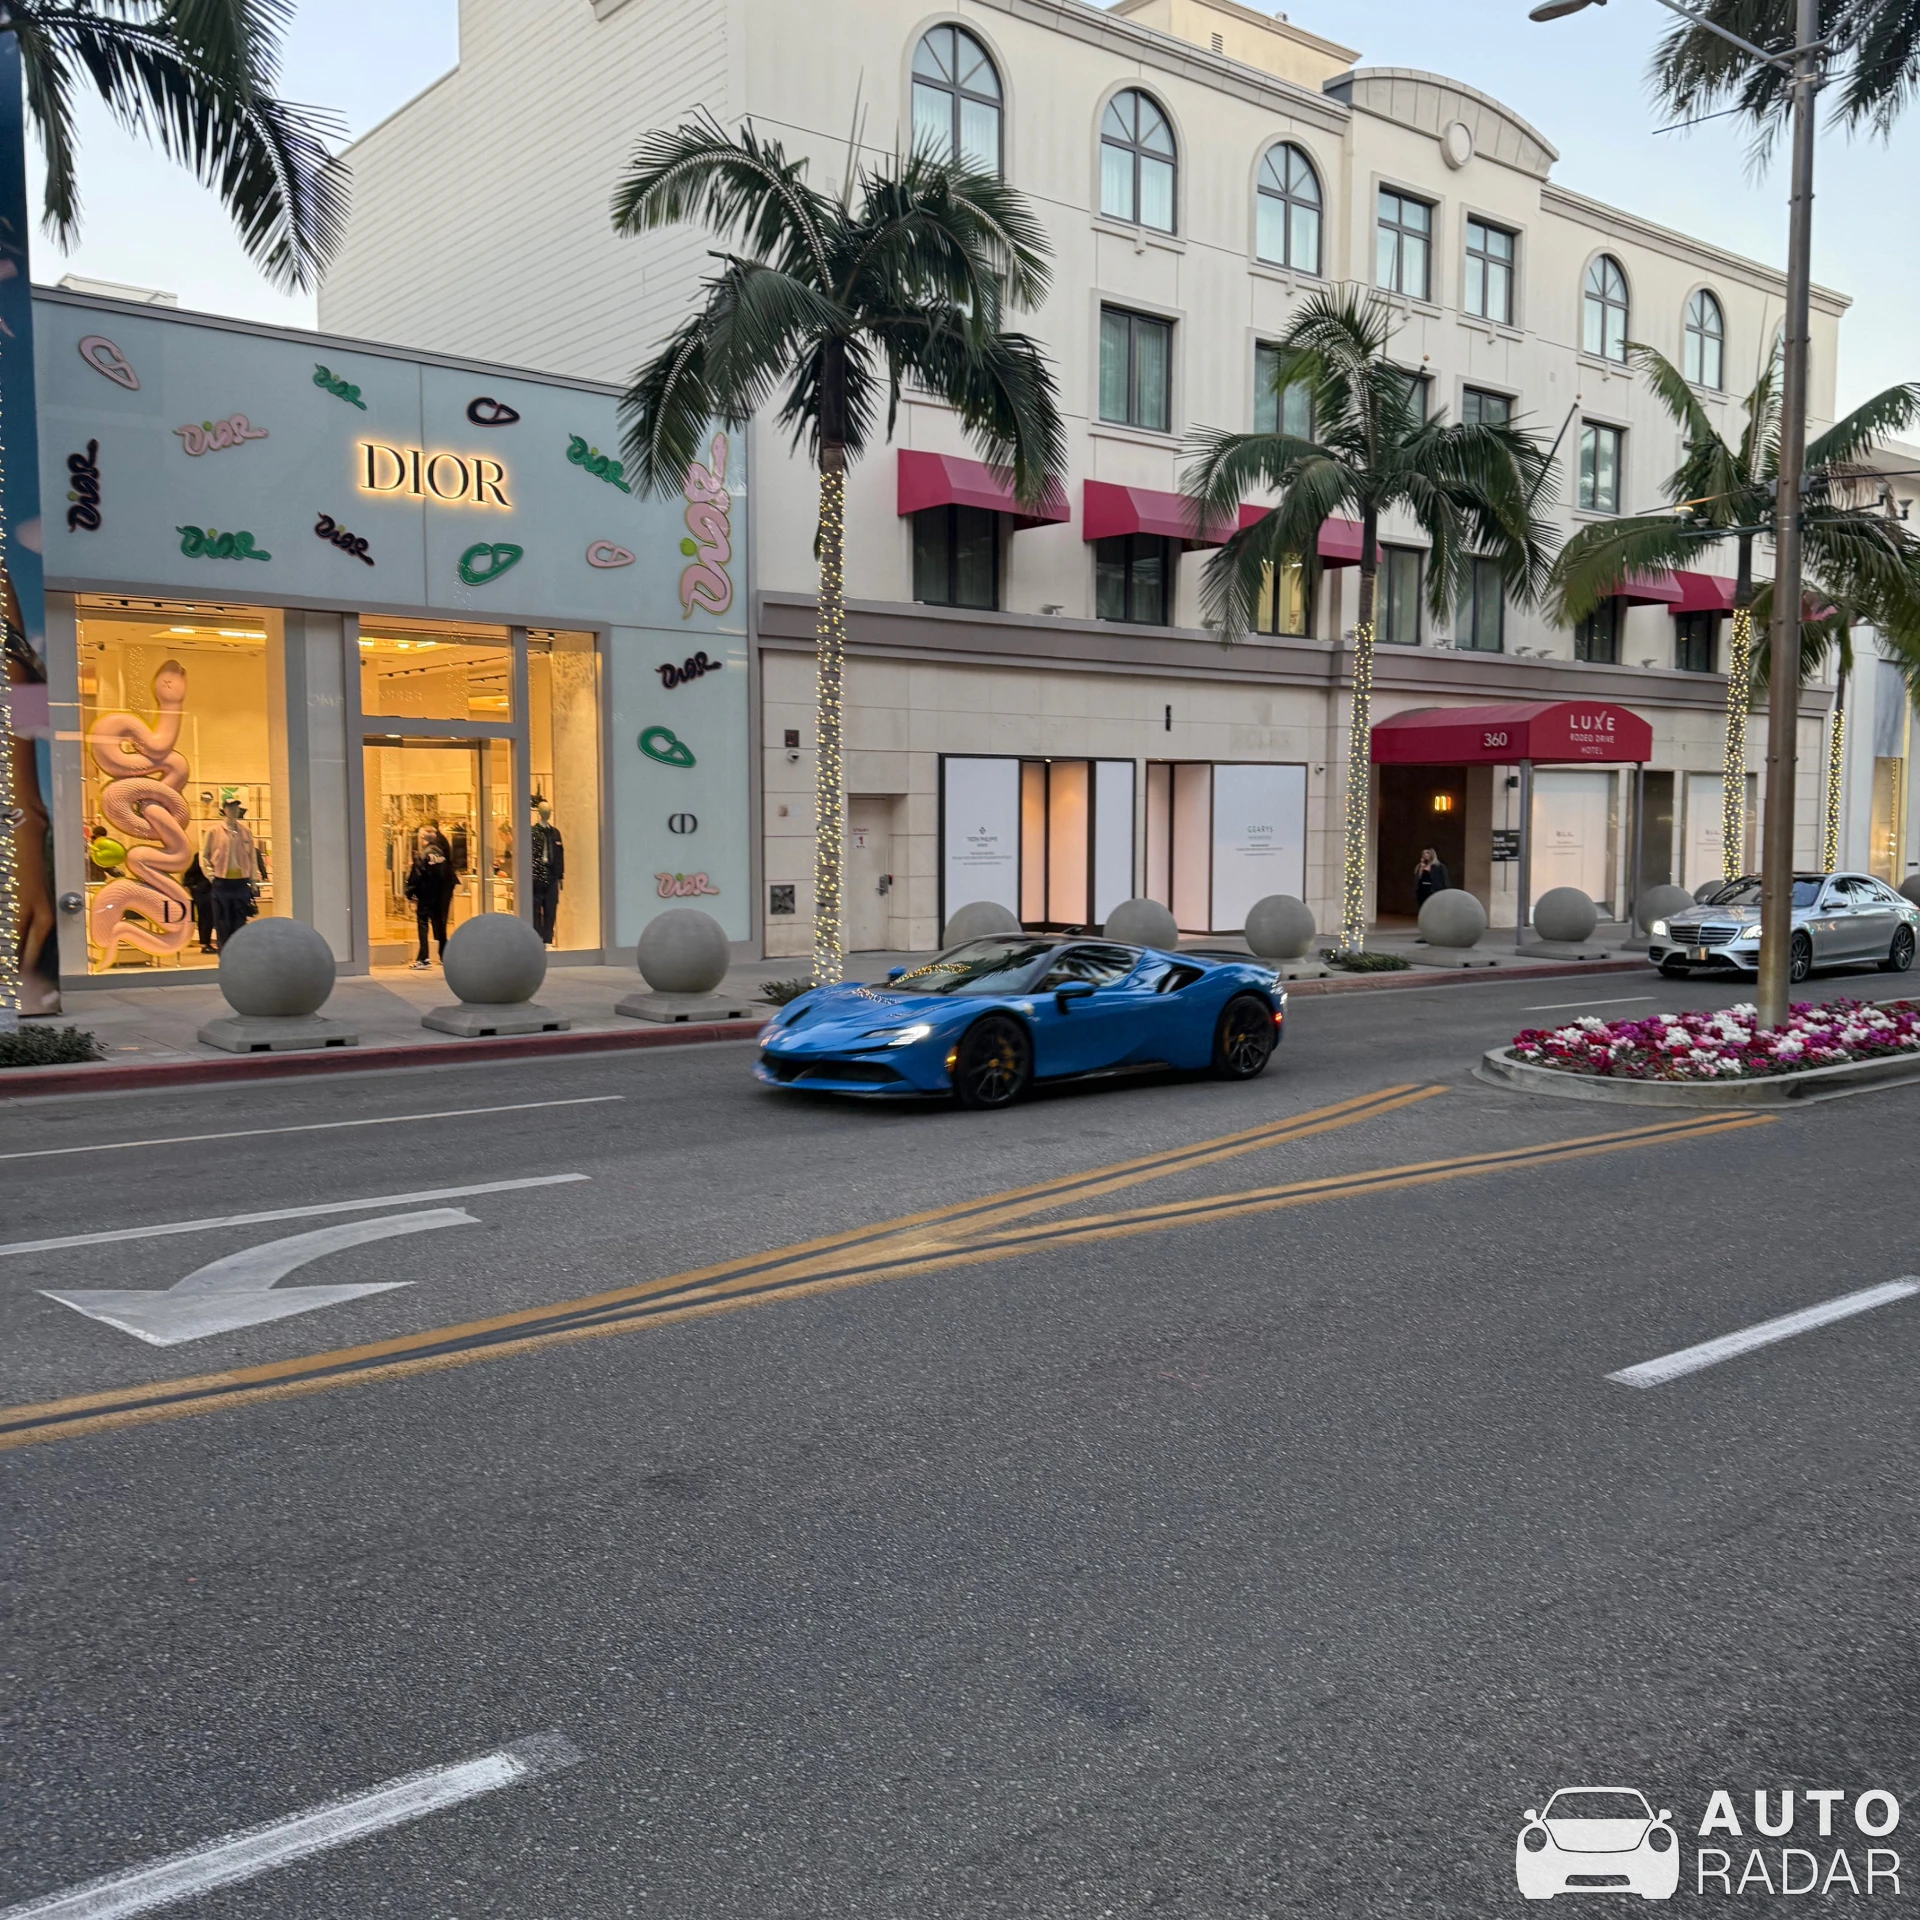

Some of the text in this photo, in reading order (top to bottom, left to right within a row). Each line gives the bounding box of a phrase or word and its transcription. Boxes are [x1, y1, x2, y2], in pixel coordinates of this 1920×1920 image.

[360, 442, 513, 508] DIOR
[1569, 710, 1616, 731] LUXE
[1483, 732, 1508, 747] 360
[1569, 733, 1594, 743] RODEO
[1580, 746, 1603, 756] HOTEL
